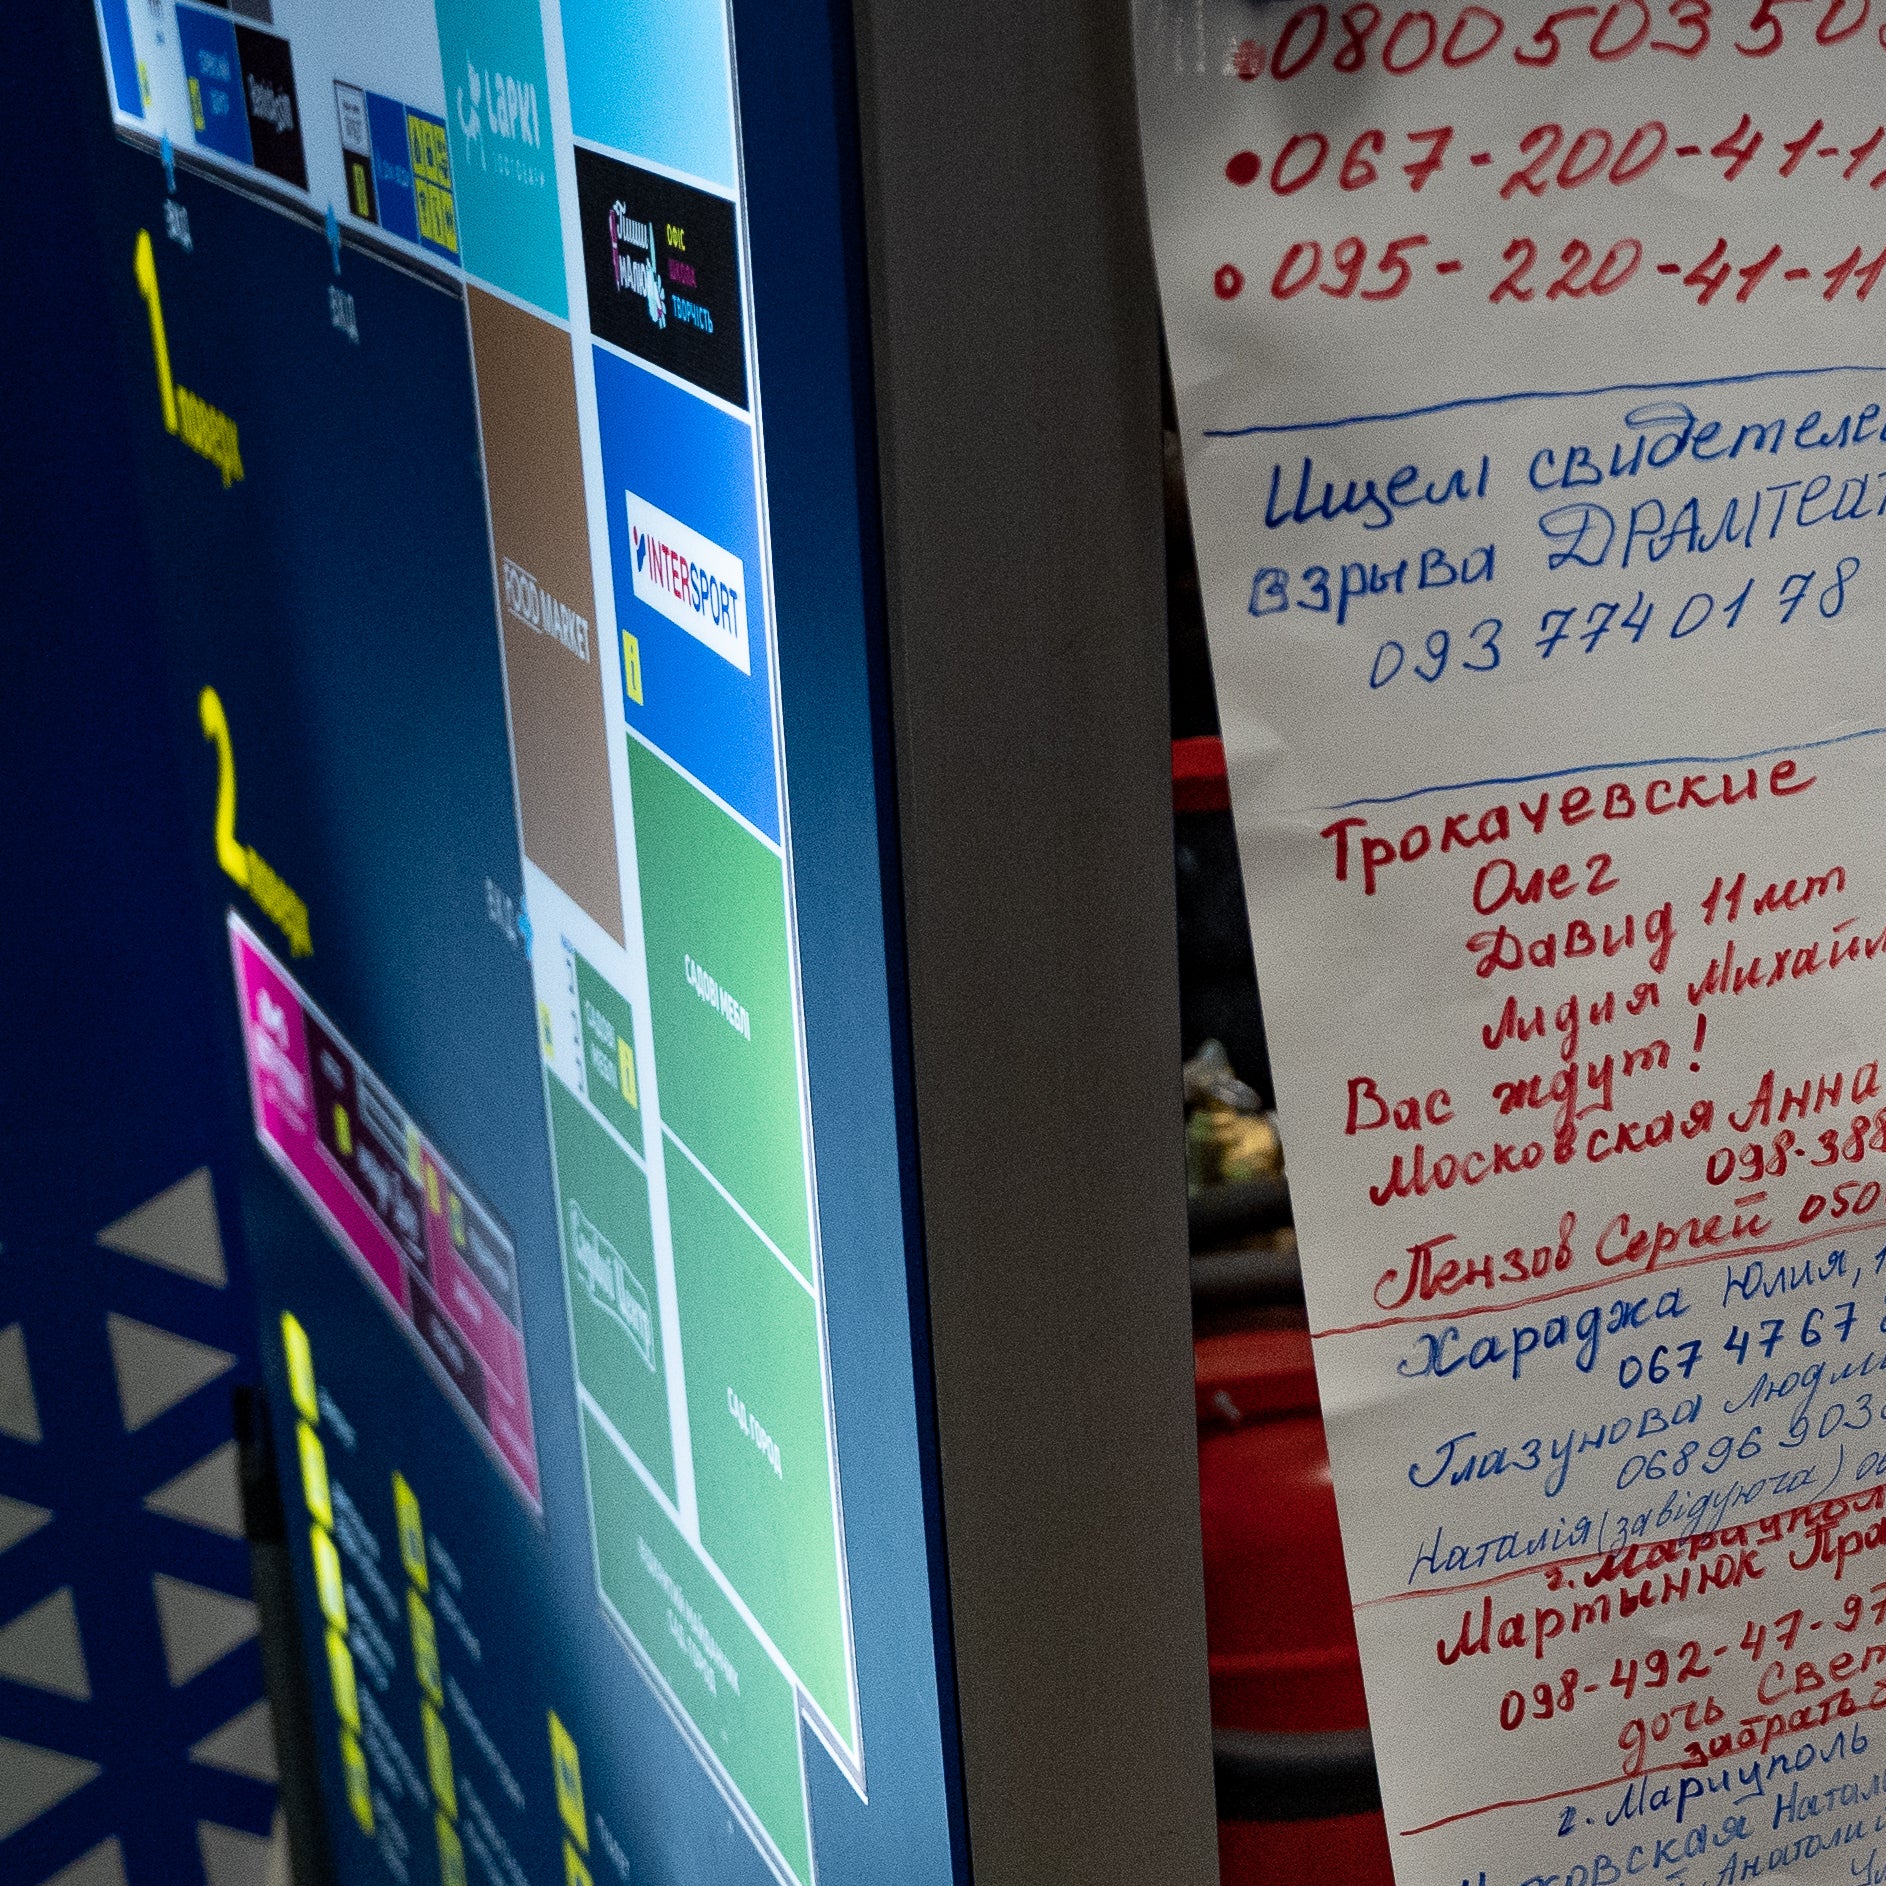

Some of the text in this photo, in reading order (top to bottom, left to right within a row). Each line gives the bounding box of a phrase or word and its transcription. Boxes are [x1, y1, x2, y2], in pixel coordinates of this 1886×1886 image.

[647, 534, 738, 638] INTERSPORT
[1465, 864, 1846, 978] Давид 11 лет
[1473, 854, 1619, 916] Олег
[1483, 981, 1661, 1061] Лидия
[1345, 1076, 1452, 1136] Вас
[1369, 1059, 1882, 1205] Московская Анна
[1374, 1191, 1775, 1309] Пензов Сергей
[1398, 1286, 1690, 1380] Хараджа
[1409, 1392, 1702, 1497] Глазунова
[1437, 1541, 1767, 1667] Мартынюк
[1604, 1724, 1870, 1825] Мариуполь
